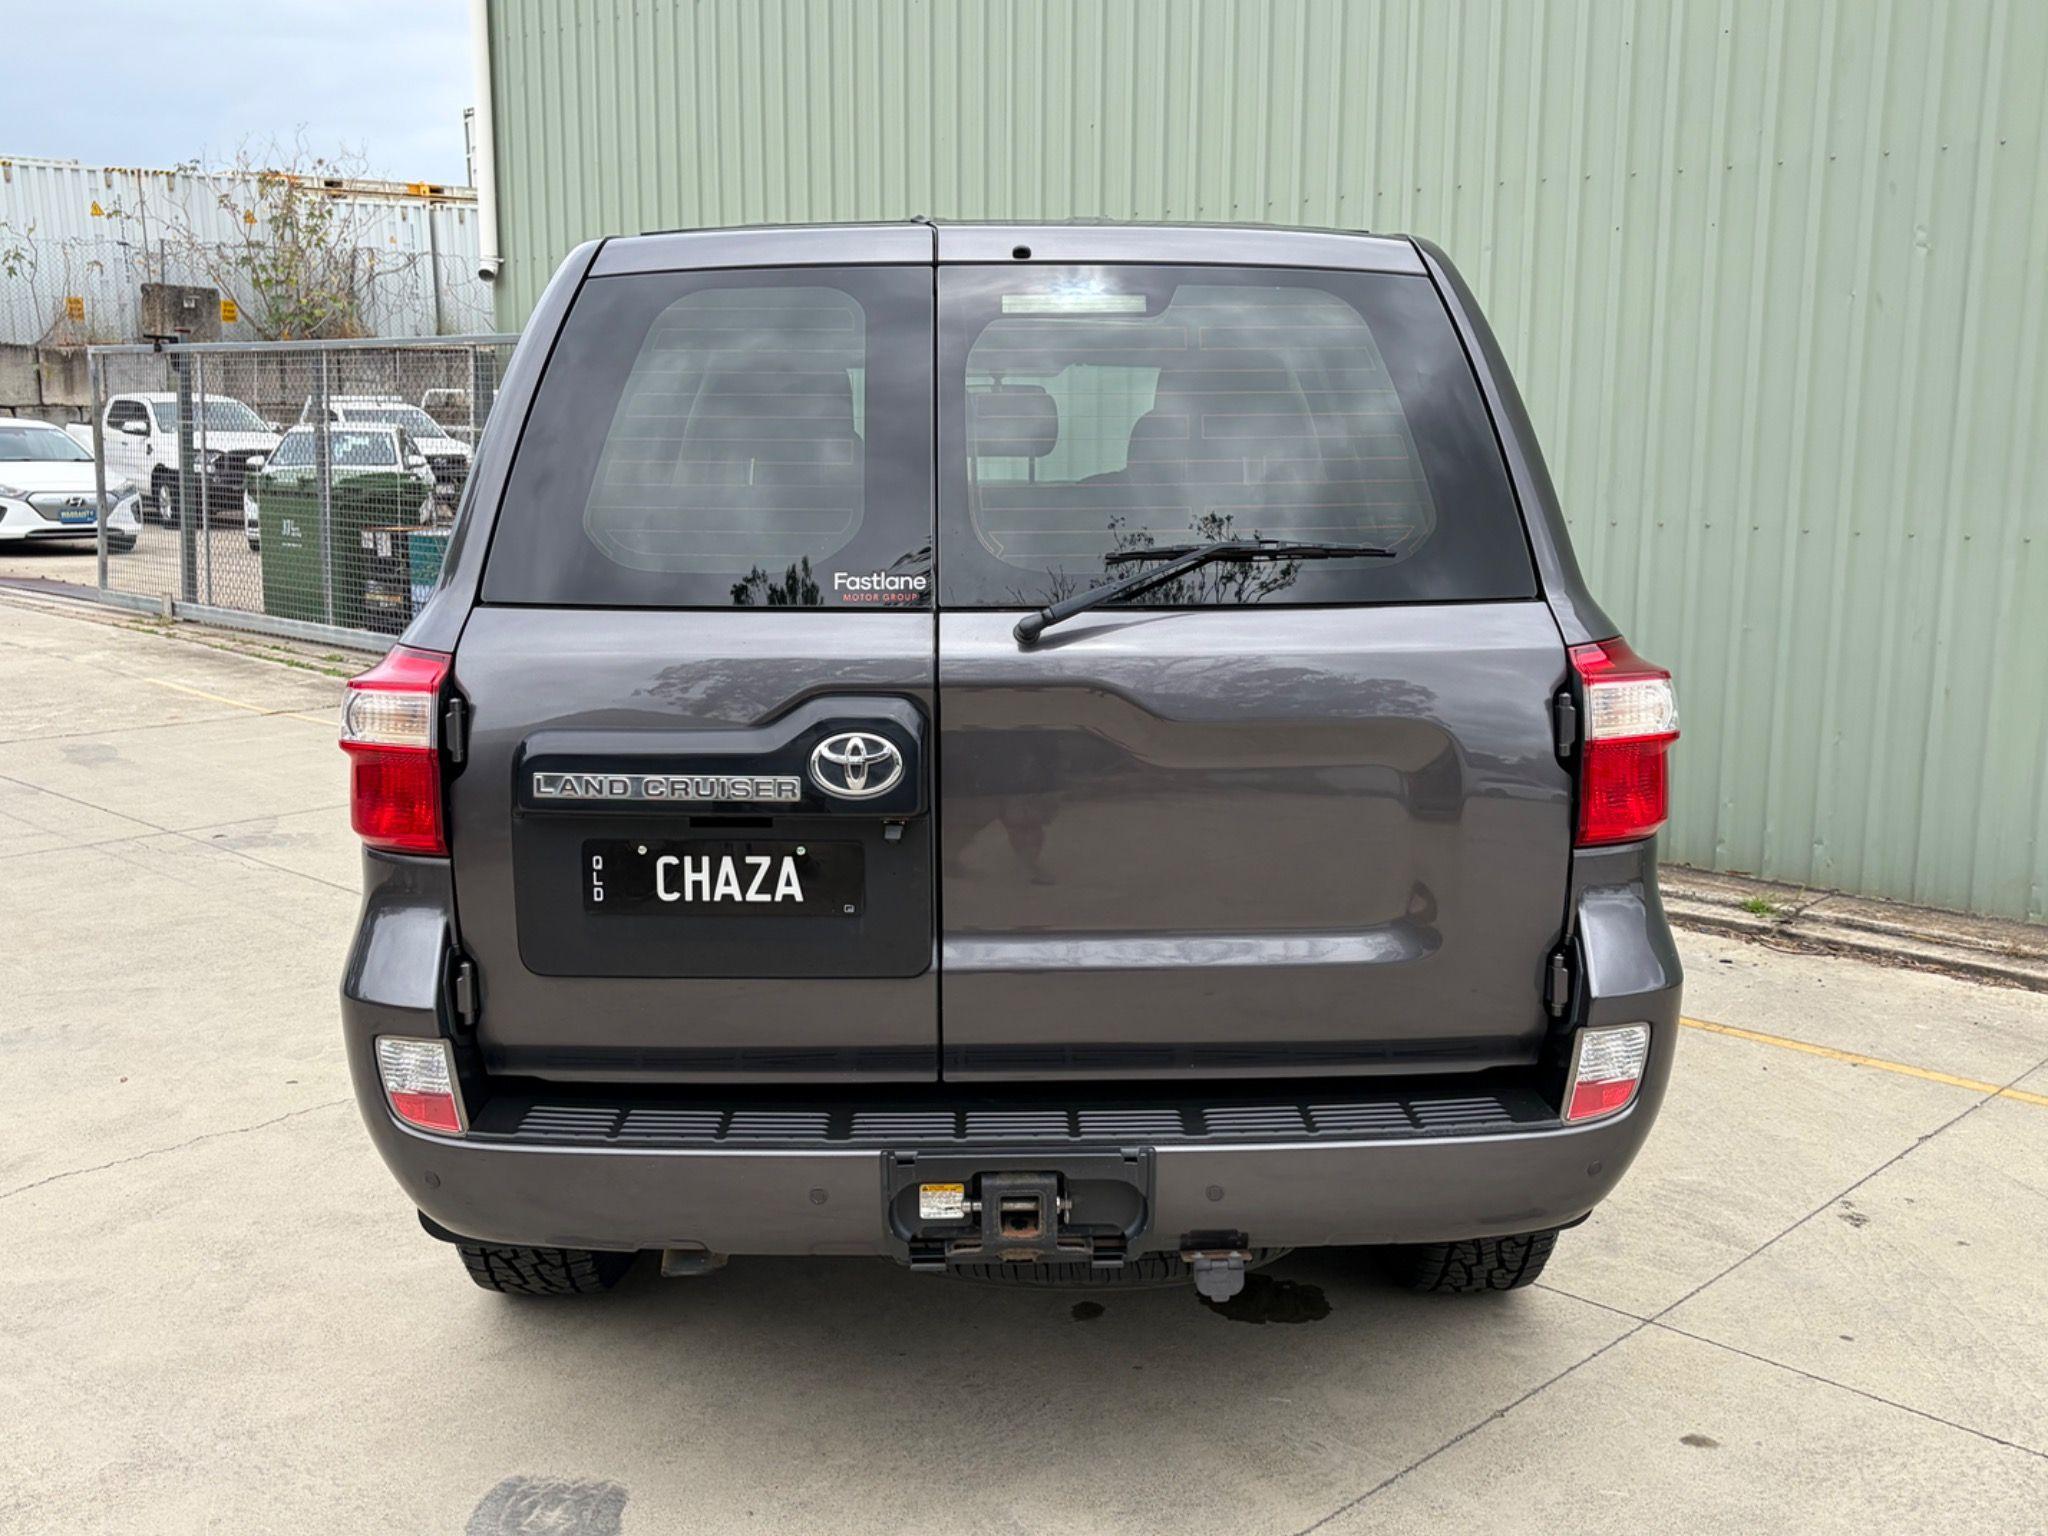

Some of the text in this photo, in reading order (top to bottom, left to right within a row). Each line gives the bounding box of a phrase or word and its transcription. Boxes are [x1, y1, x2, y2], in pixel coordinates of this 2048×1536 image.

[834, 571, 926, 590] Fastlane
[842, 593, 918, 602] MOTOR GROUP
[535, 776, 799, 800] LAND CRUISER
[592, 856, 604, 902] QLD
[656, 855, 804, 902] CHAZA
